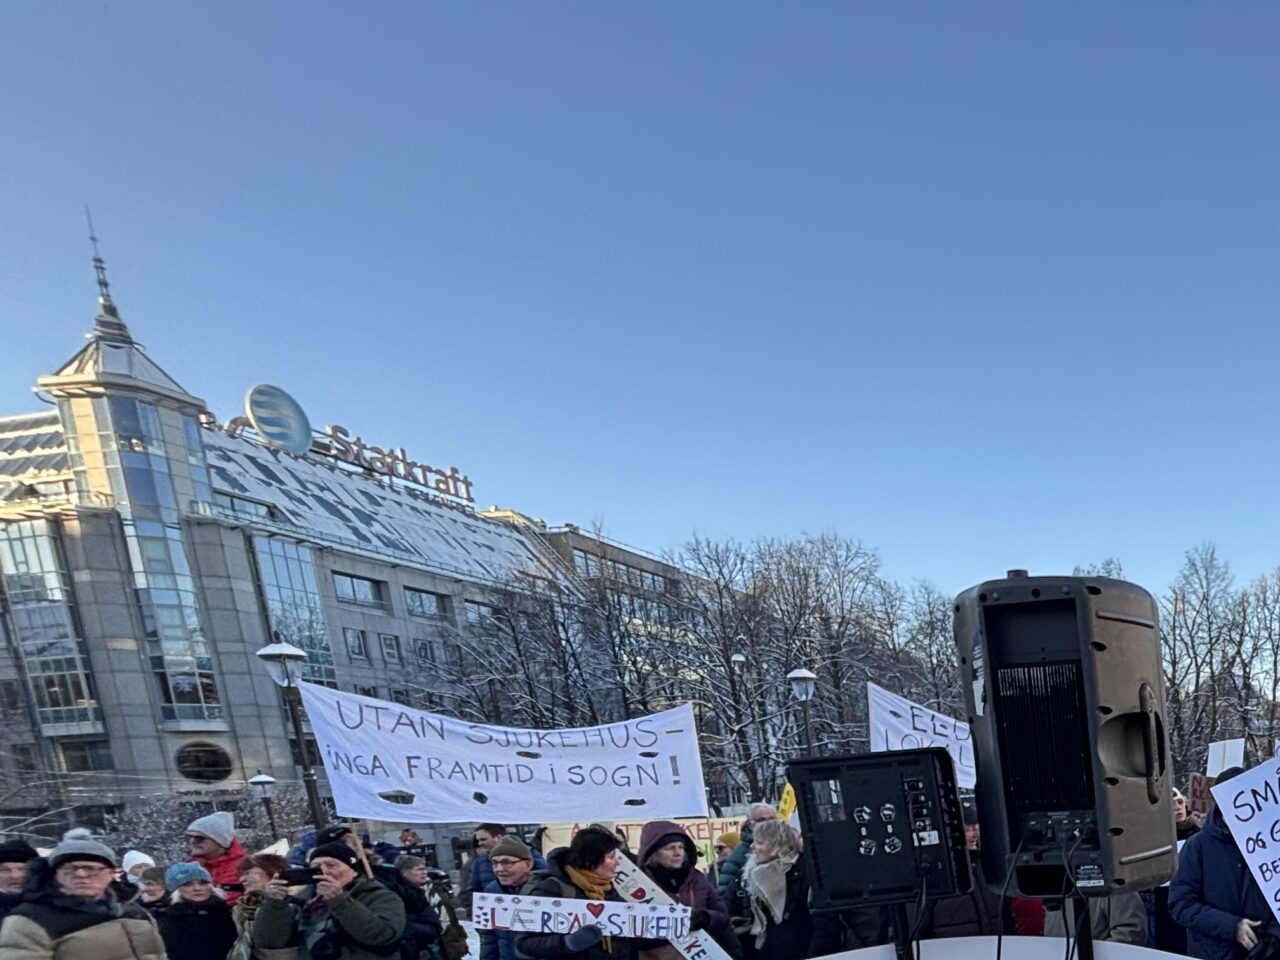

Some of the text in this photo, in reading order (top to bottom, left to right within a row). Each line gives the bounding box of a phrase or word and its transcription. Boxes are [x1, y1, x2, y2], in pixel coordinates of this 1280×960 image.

[328, 424, 475, 503] Statkraft
[336, 700, 446, 741] UTAN
[1245, 831, 1268, 854] OG
